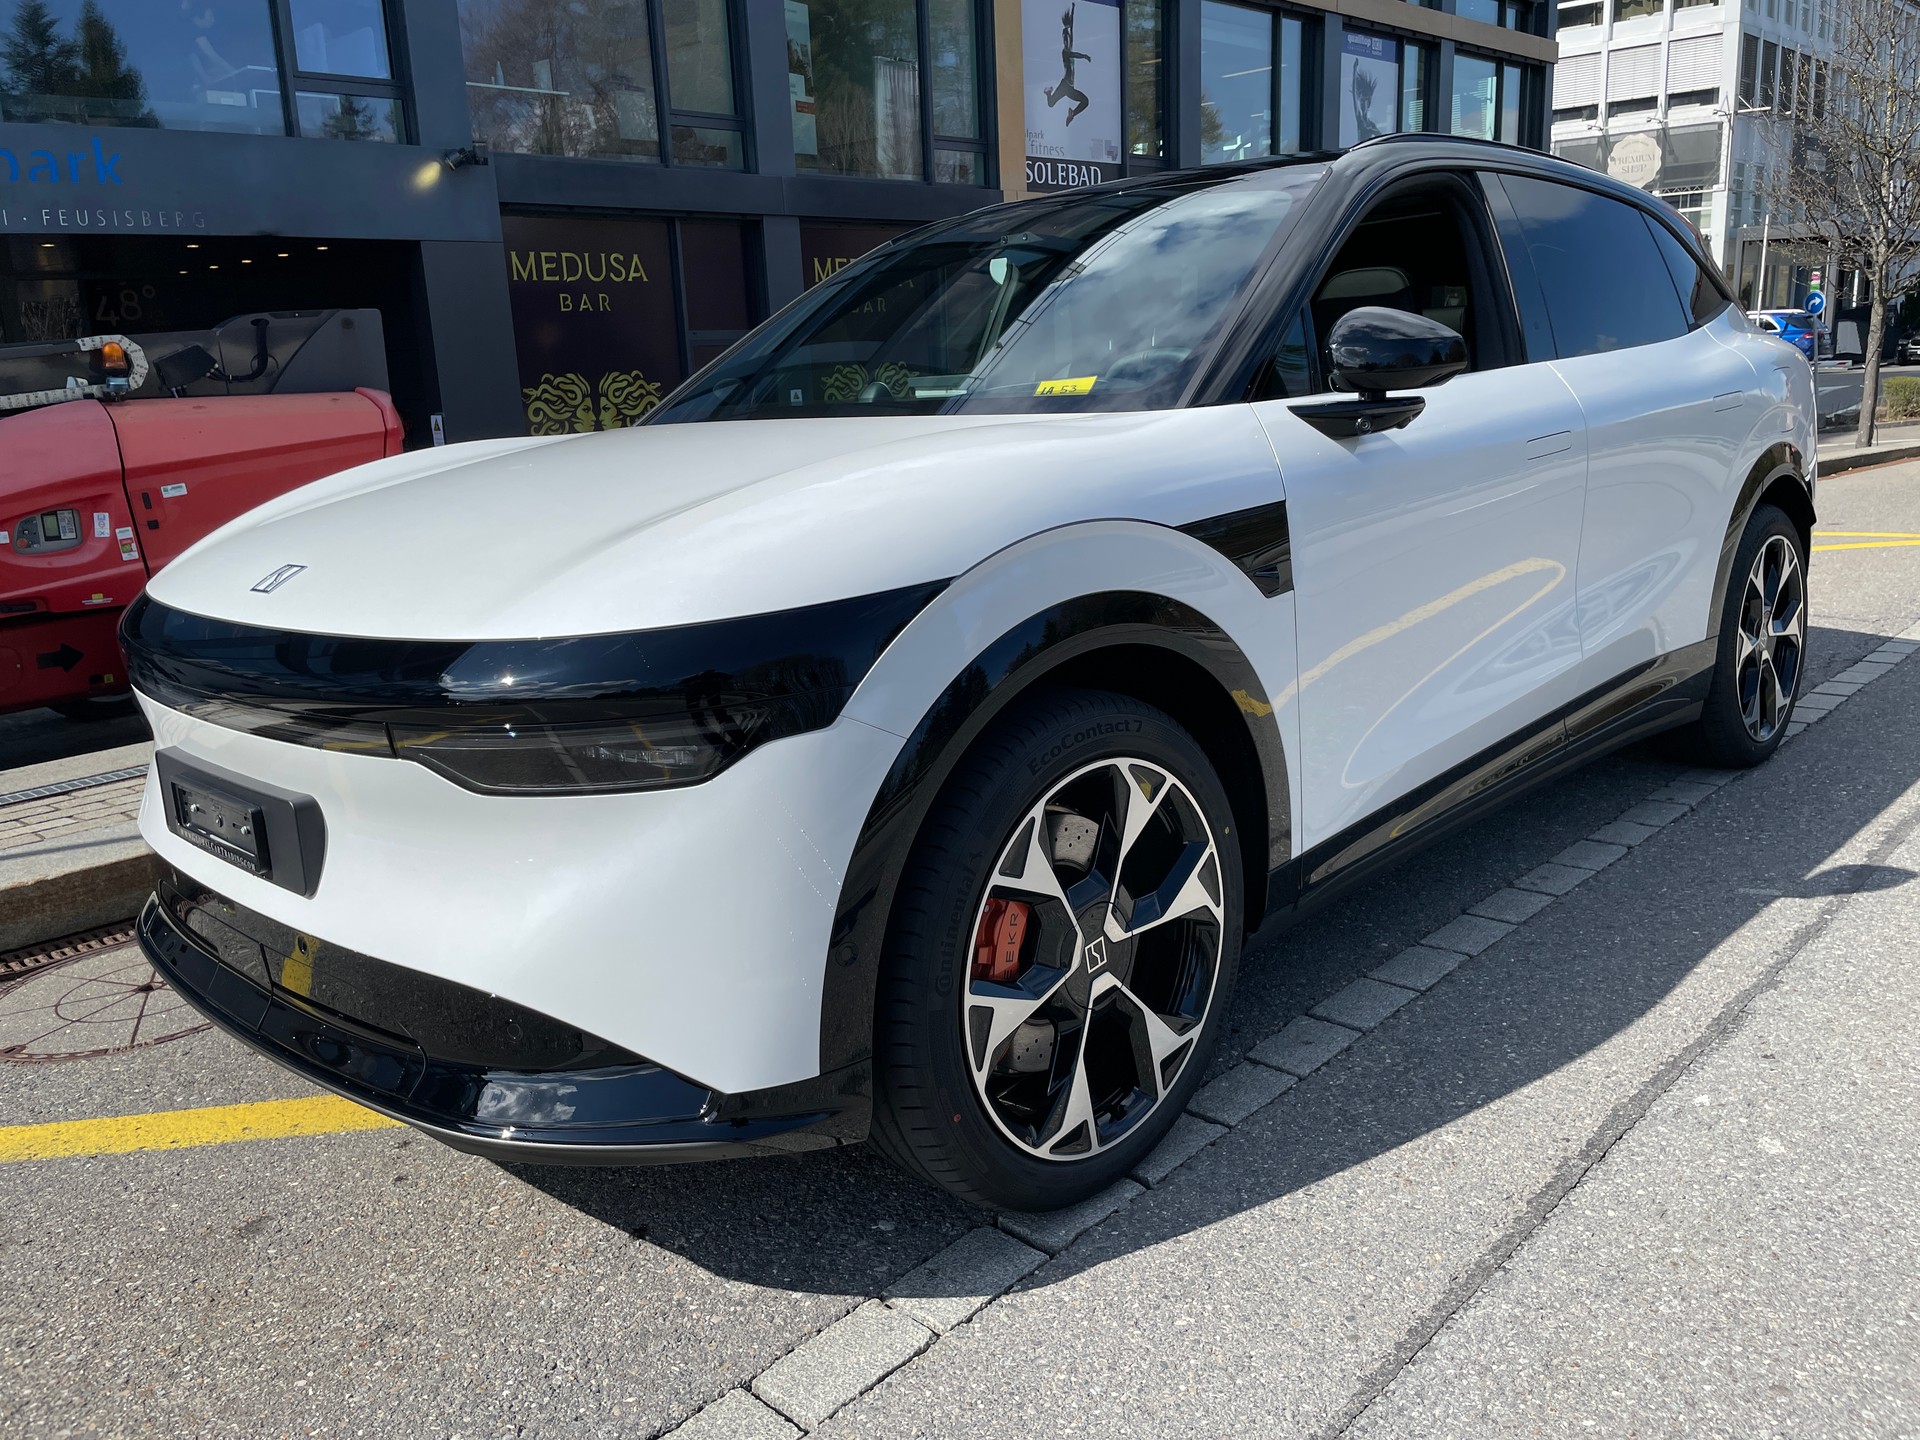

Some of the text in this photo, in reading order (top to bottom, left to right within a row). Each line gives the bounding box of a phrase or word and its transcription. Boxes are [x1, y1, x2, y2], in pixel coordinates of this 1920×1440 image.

[1025, 129, 1045, 141] lpark
[1030, 139, 1065, 157] fitness
[1026, 161, 1102, 188] SOLEBAD
[42, 209, 205, 229] FEUSISBERG
[510, 250, 649, 284] MEDUSA
[559, 293, 611, 312] BAR
[1026, 719, 1143, 776] EcoContact 7
[1003, 912, 1019, 980] EEKR
